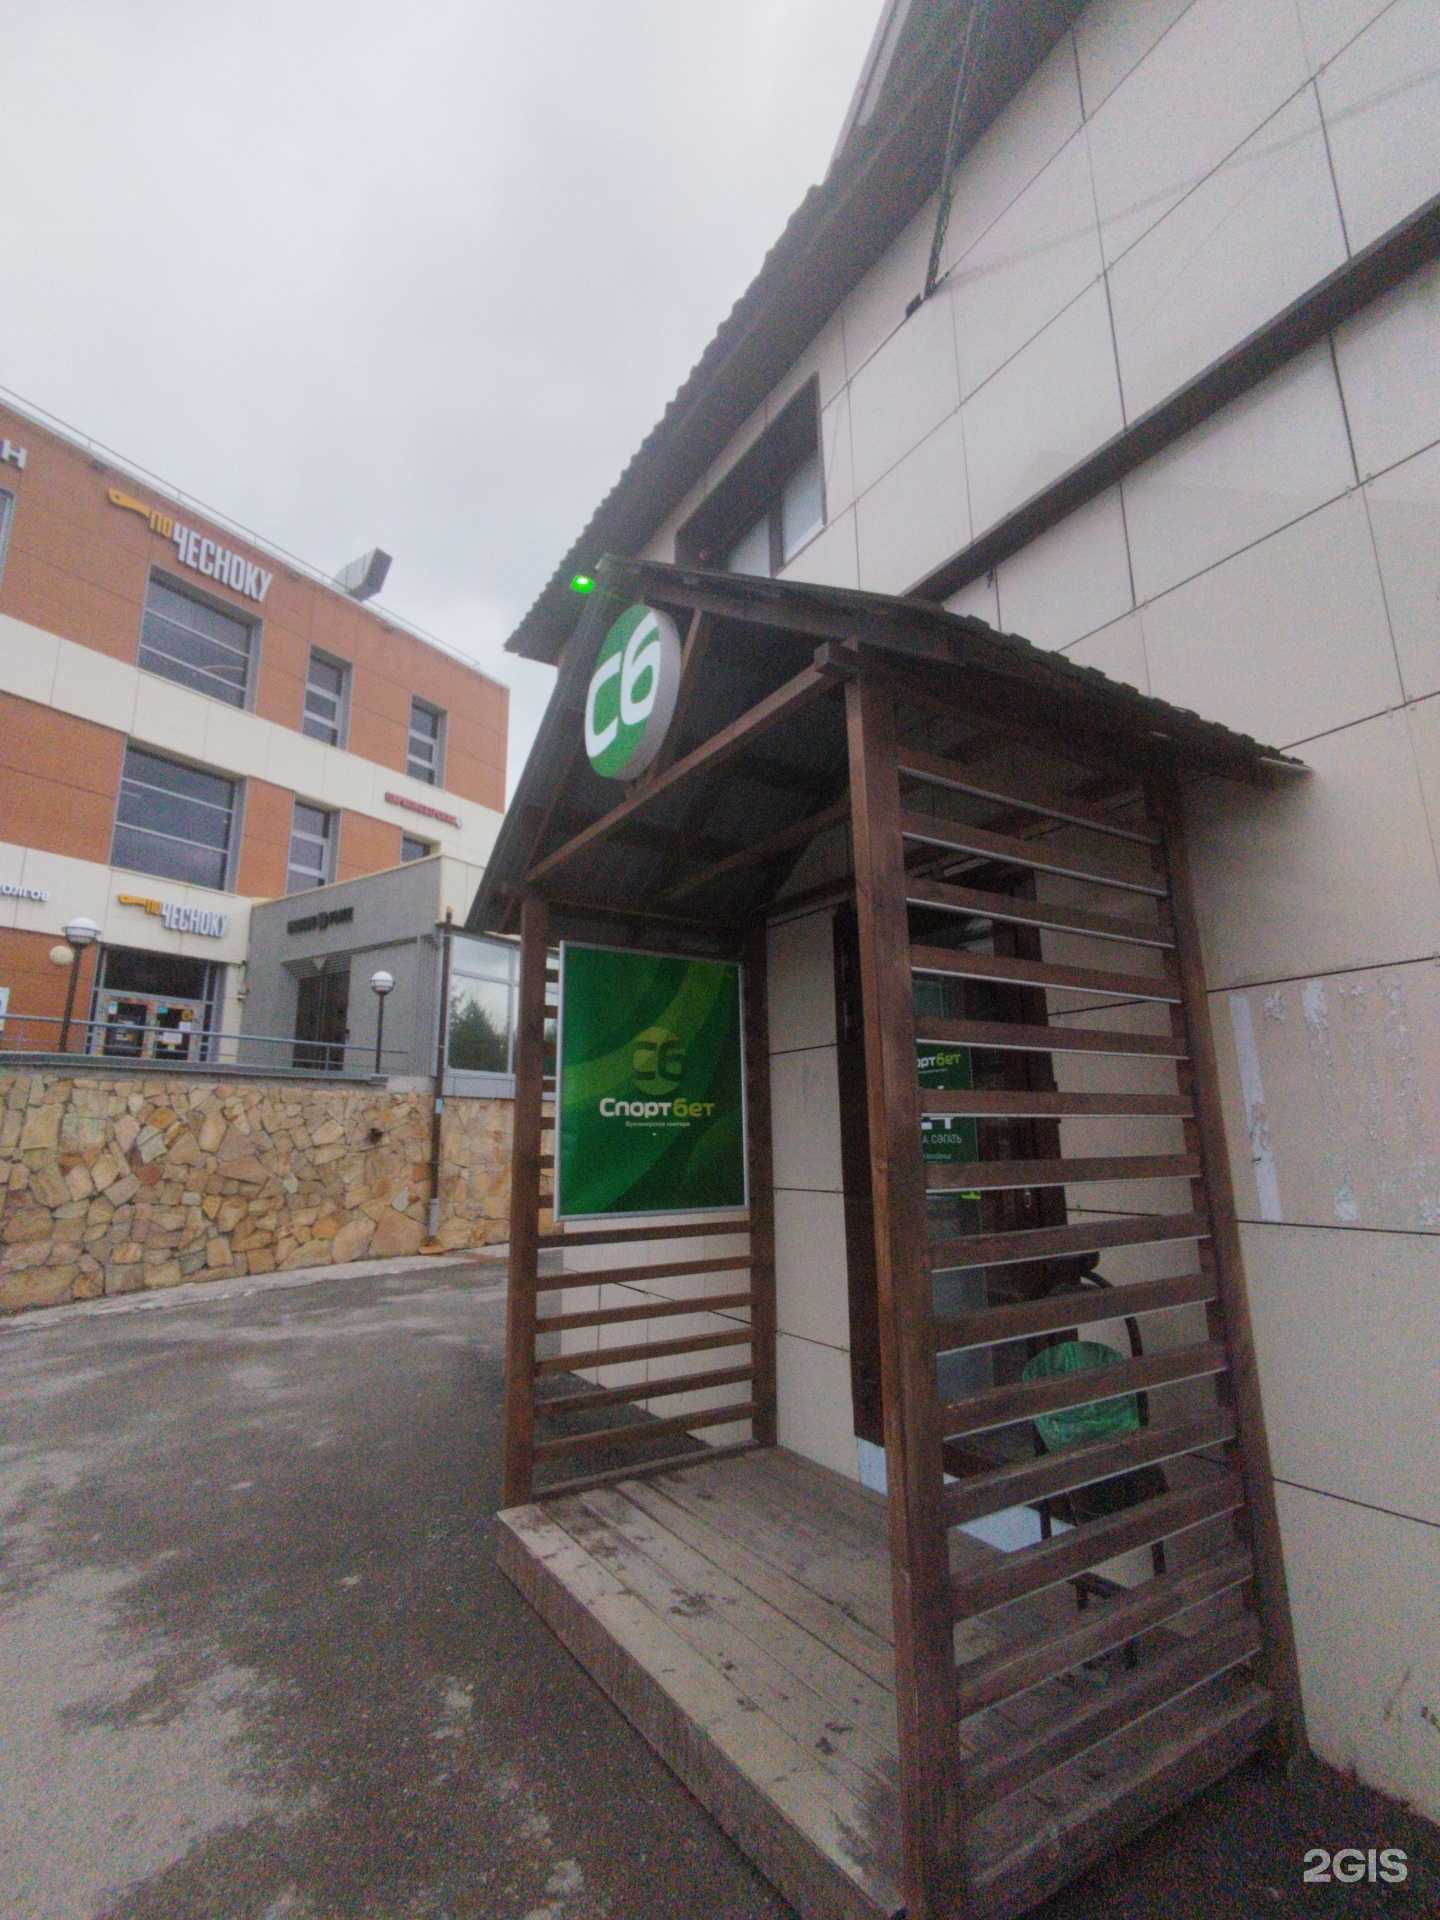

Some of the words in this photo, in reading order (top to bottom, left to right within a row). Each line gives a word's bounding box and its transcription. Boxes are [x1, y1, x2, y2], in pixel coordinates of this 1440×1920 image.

[172, 523, 273, 602] ЧЕСНОКУ
[161, 901, 230, 937] ЧЕСНОКУ
[599, 1098, 716, 1119] Спортбет
